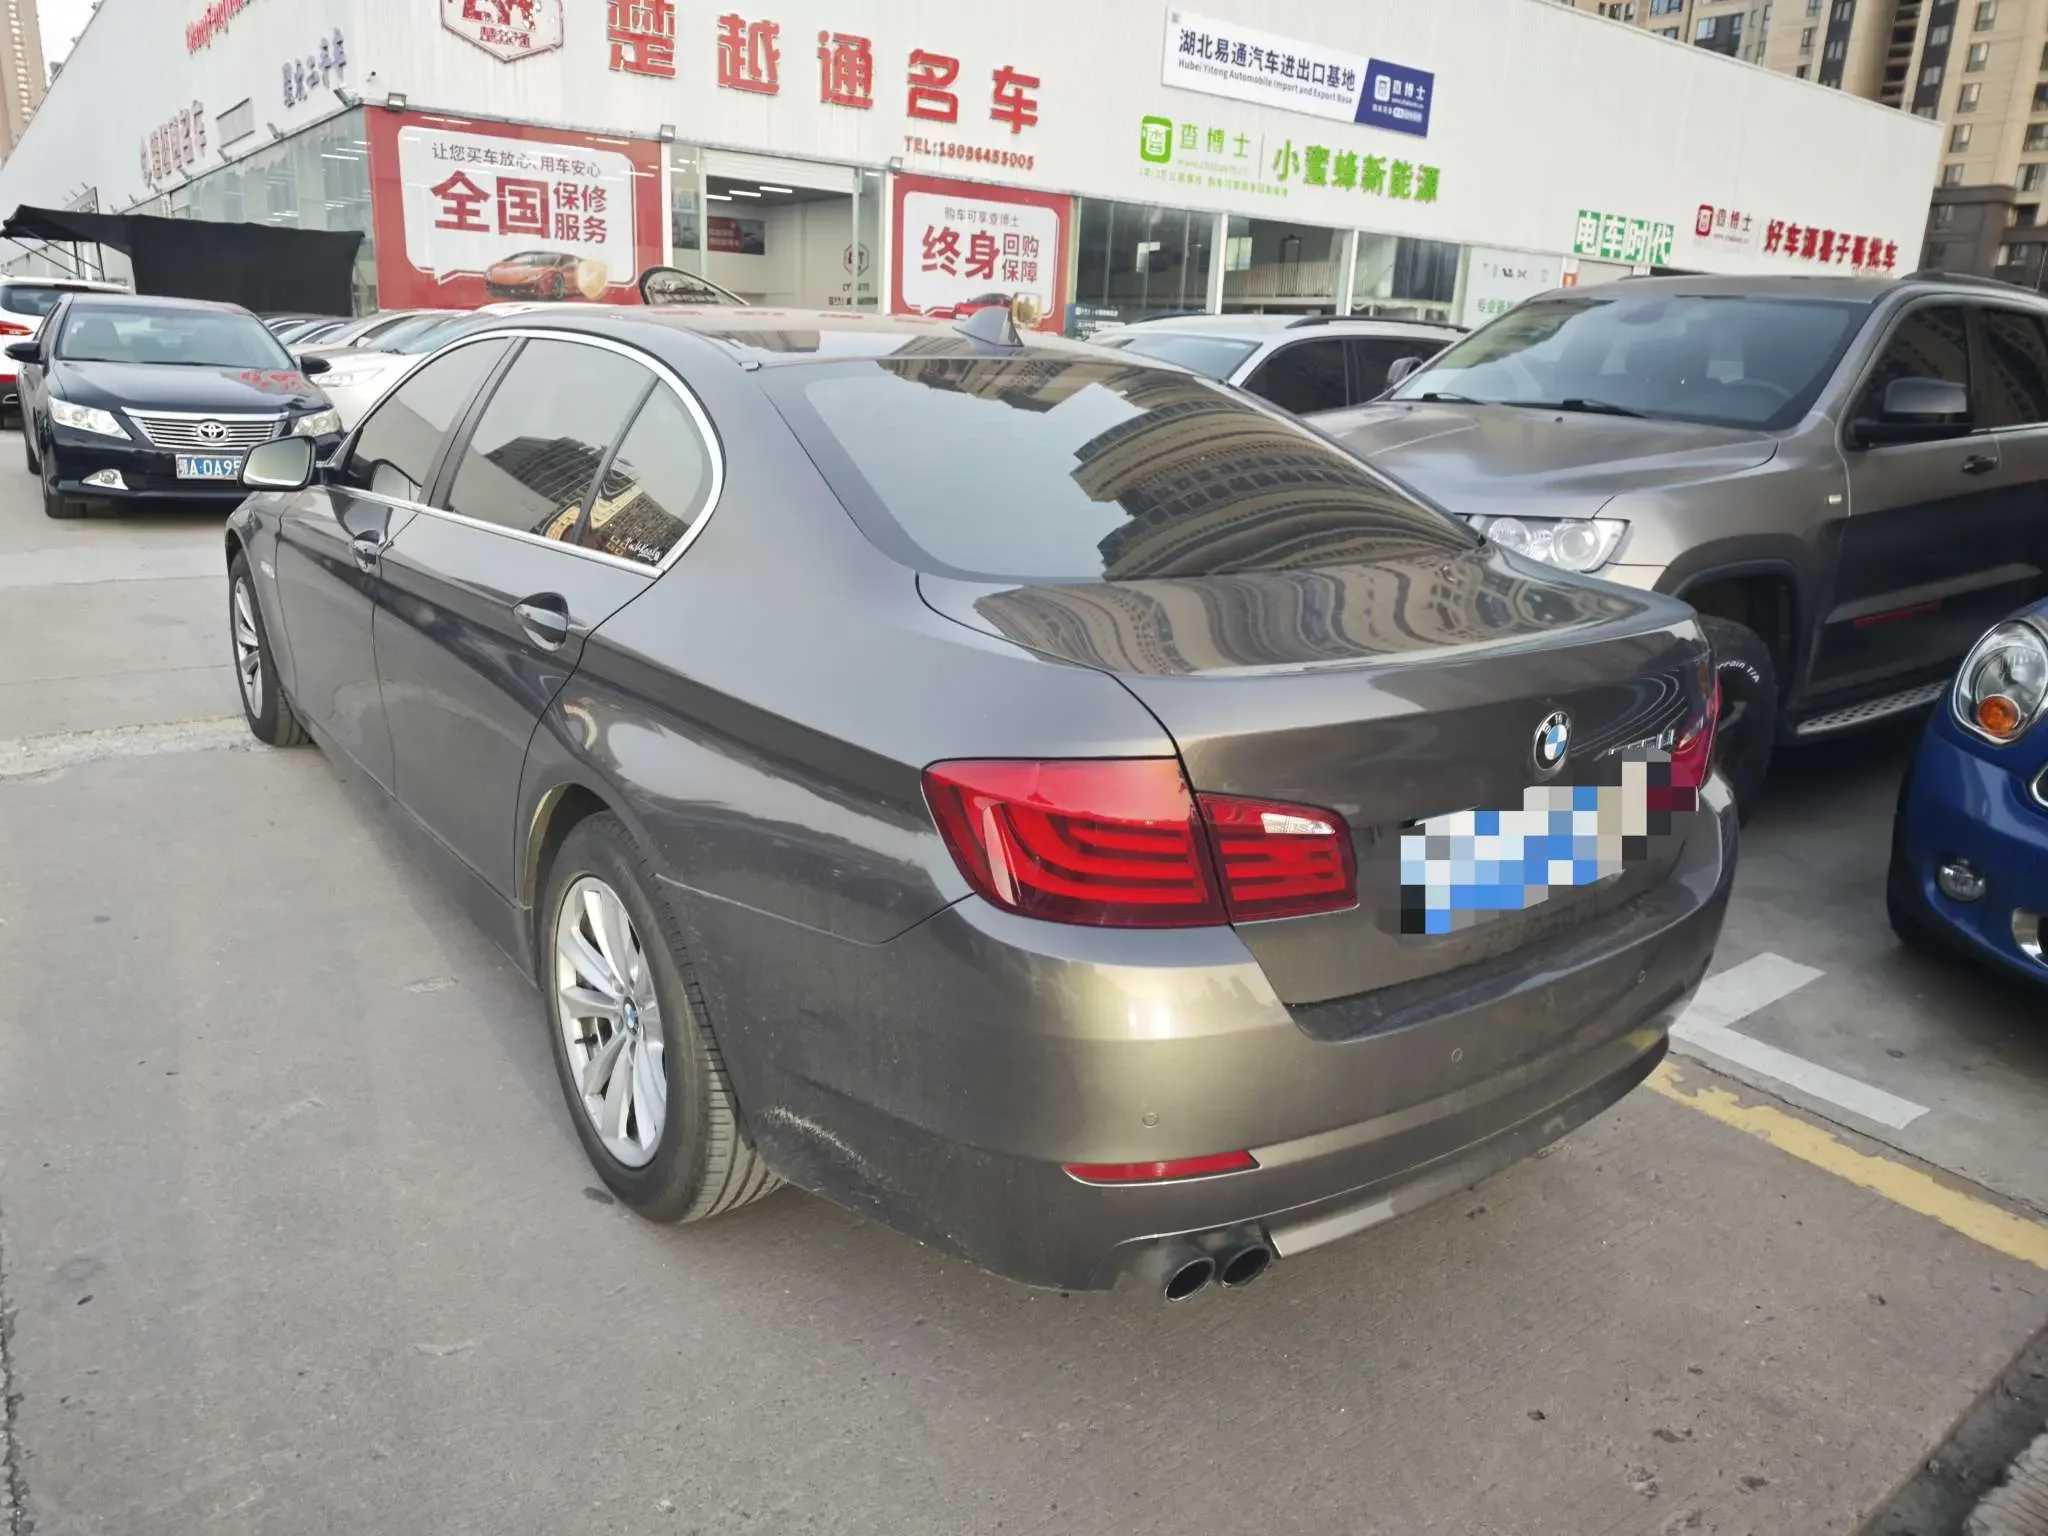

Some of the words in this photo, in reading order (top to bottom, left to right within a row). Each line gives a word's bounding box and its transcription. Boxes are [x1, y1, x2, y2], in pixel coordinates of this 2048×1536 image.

[606, 0, 1040, 134] 楚越通名车
[1178, 28, 1356, 92] 湖北易通汽车进出口基地
[1178, 58, 1202, 72] Hubei
[1229, 69, 1272, 88] Automobile
[432, 142, 601, 178] 让您买车放心、用车安心
[430, 170, 551, 239] 全国
[553, 180, 608, 213] 保修
[554, 213, 608, 244] 服务
[1002, 232, 1040, 258] 回购
[1574, 209, 1674, 266] 电车时代
[921, 224, 1001, 280] 终身
[1001, 259, 1038, 285] 保障
